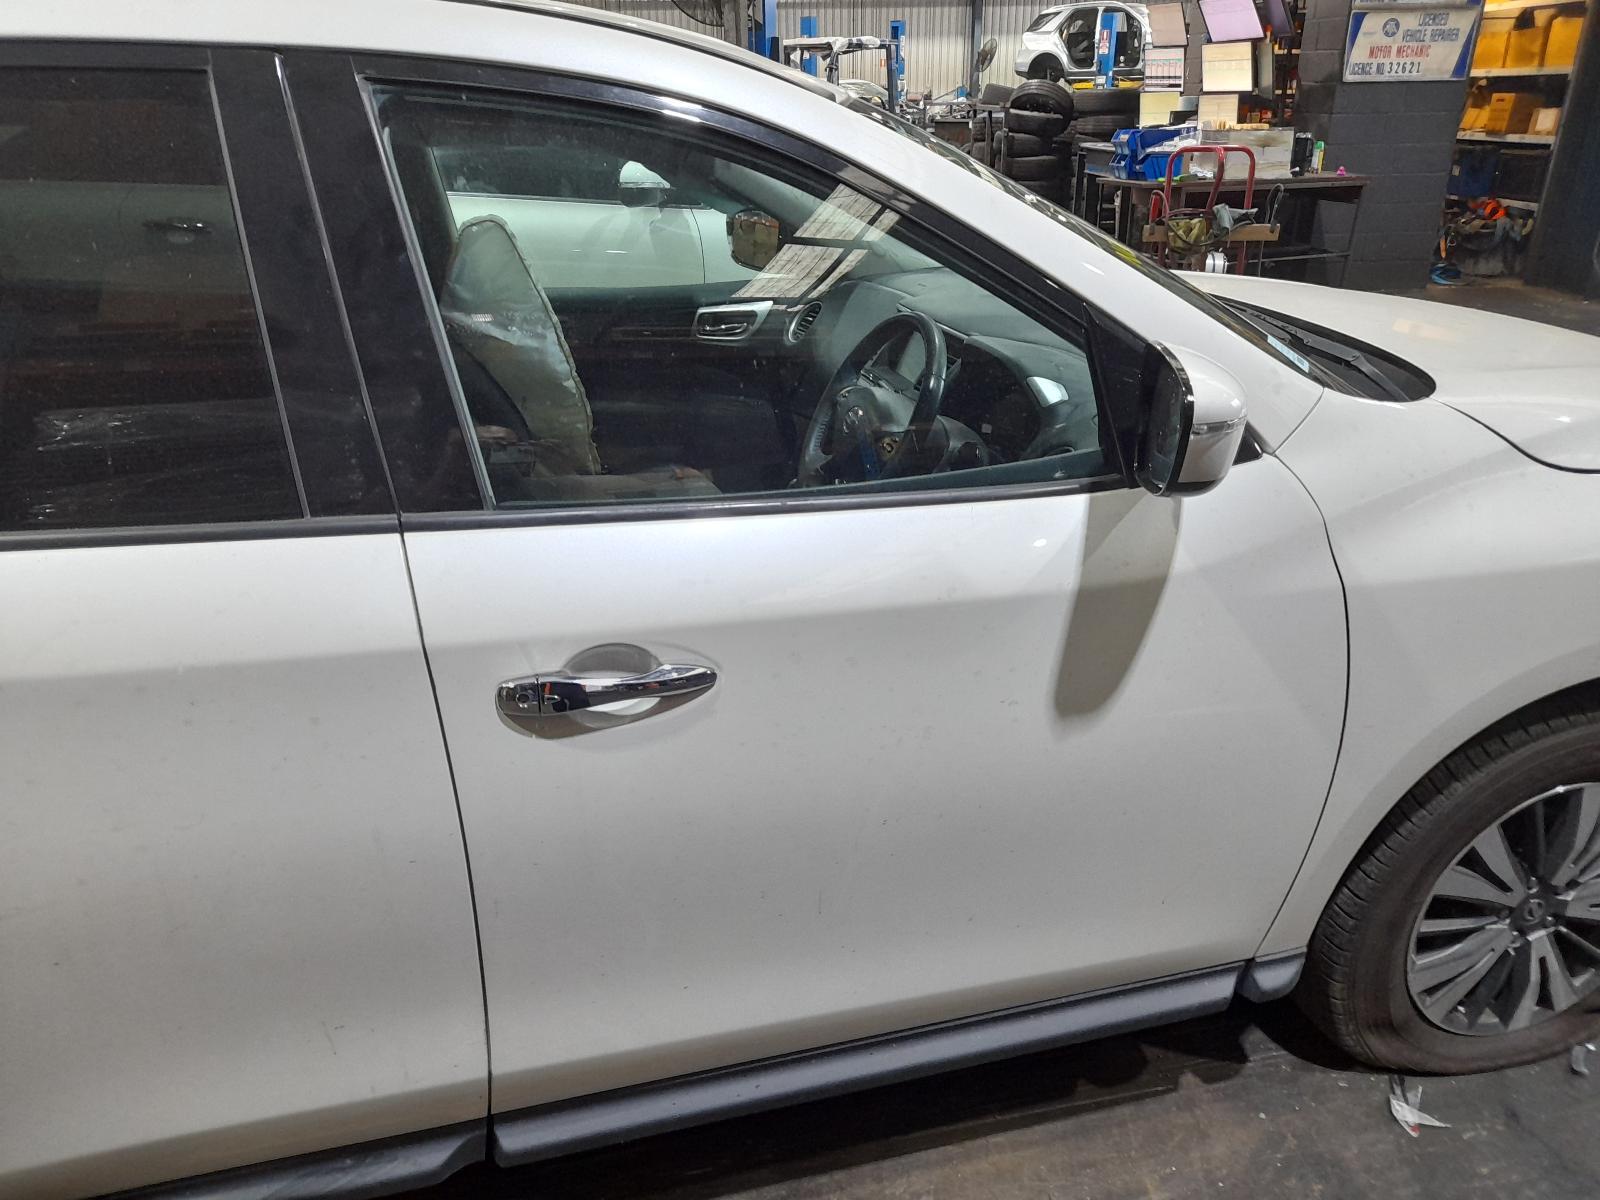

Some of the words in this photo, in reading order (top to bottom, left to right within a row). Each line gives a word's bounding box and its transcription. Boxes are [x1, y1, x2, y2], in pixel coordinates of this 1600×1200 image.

[1418, 12, 1449, 26] LICENSED
[1402, 28, 1426, 43] VEHICLE
[1430, 28, 1460, 42] REPAIRER
[1368, 45, 1392, 59] MOTOR
[1396, 45, 1431, 58] MECHANIC
[1349, 62, 1373, 75] LICENCE
[1388, 61, 1421, 74] 32621
